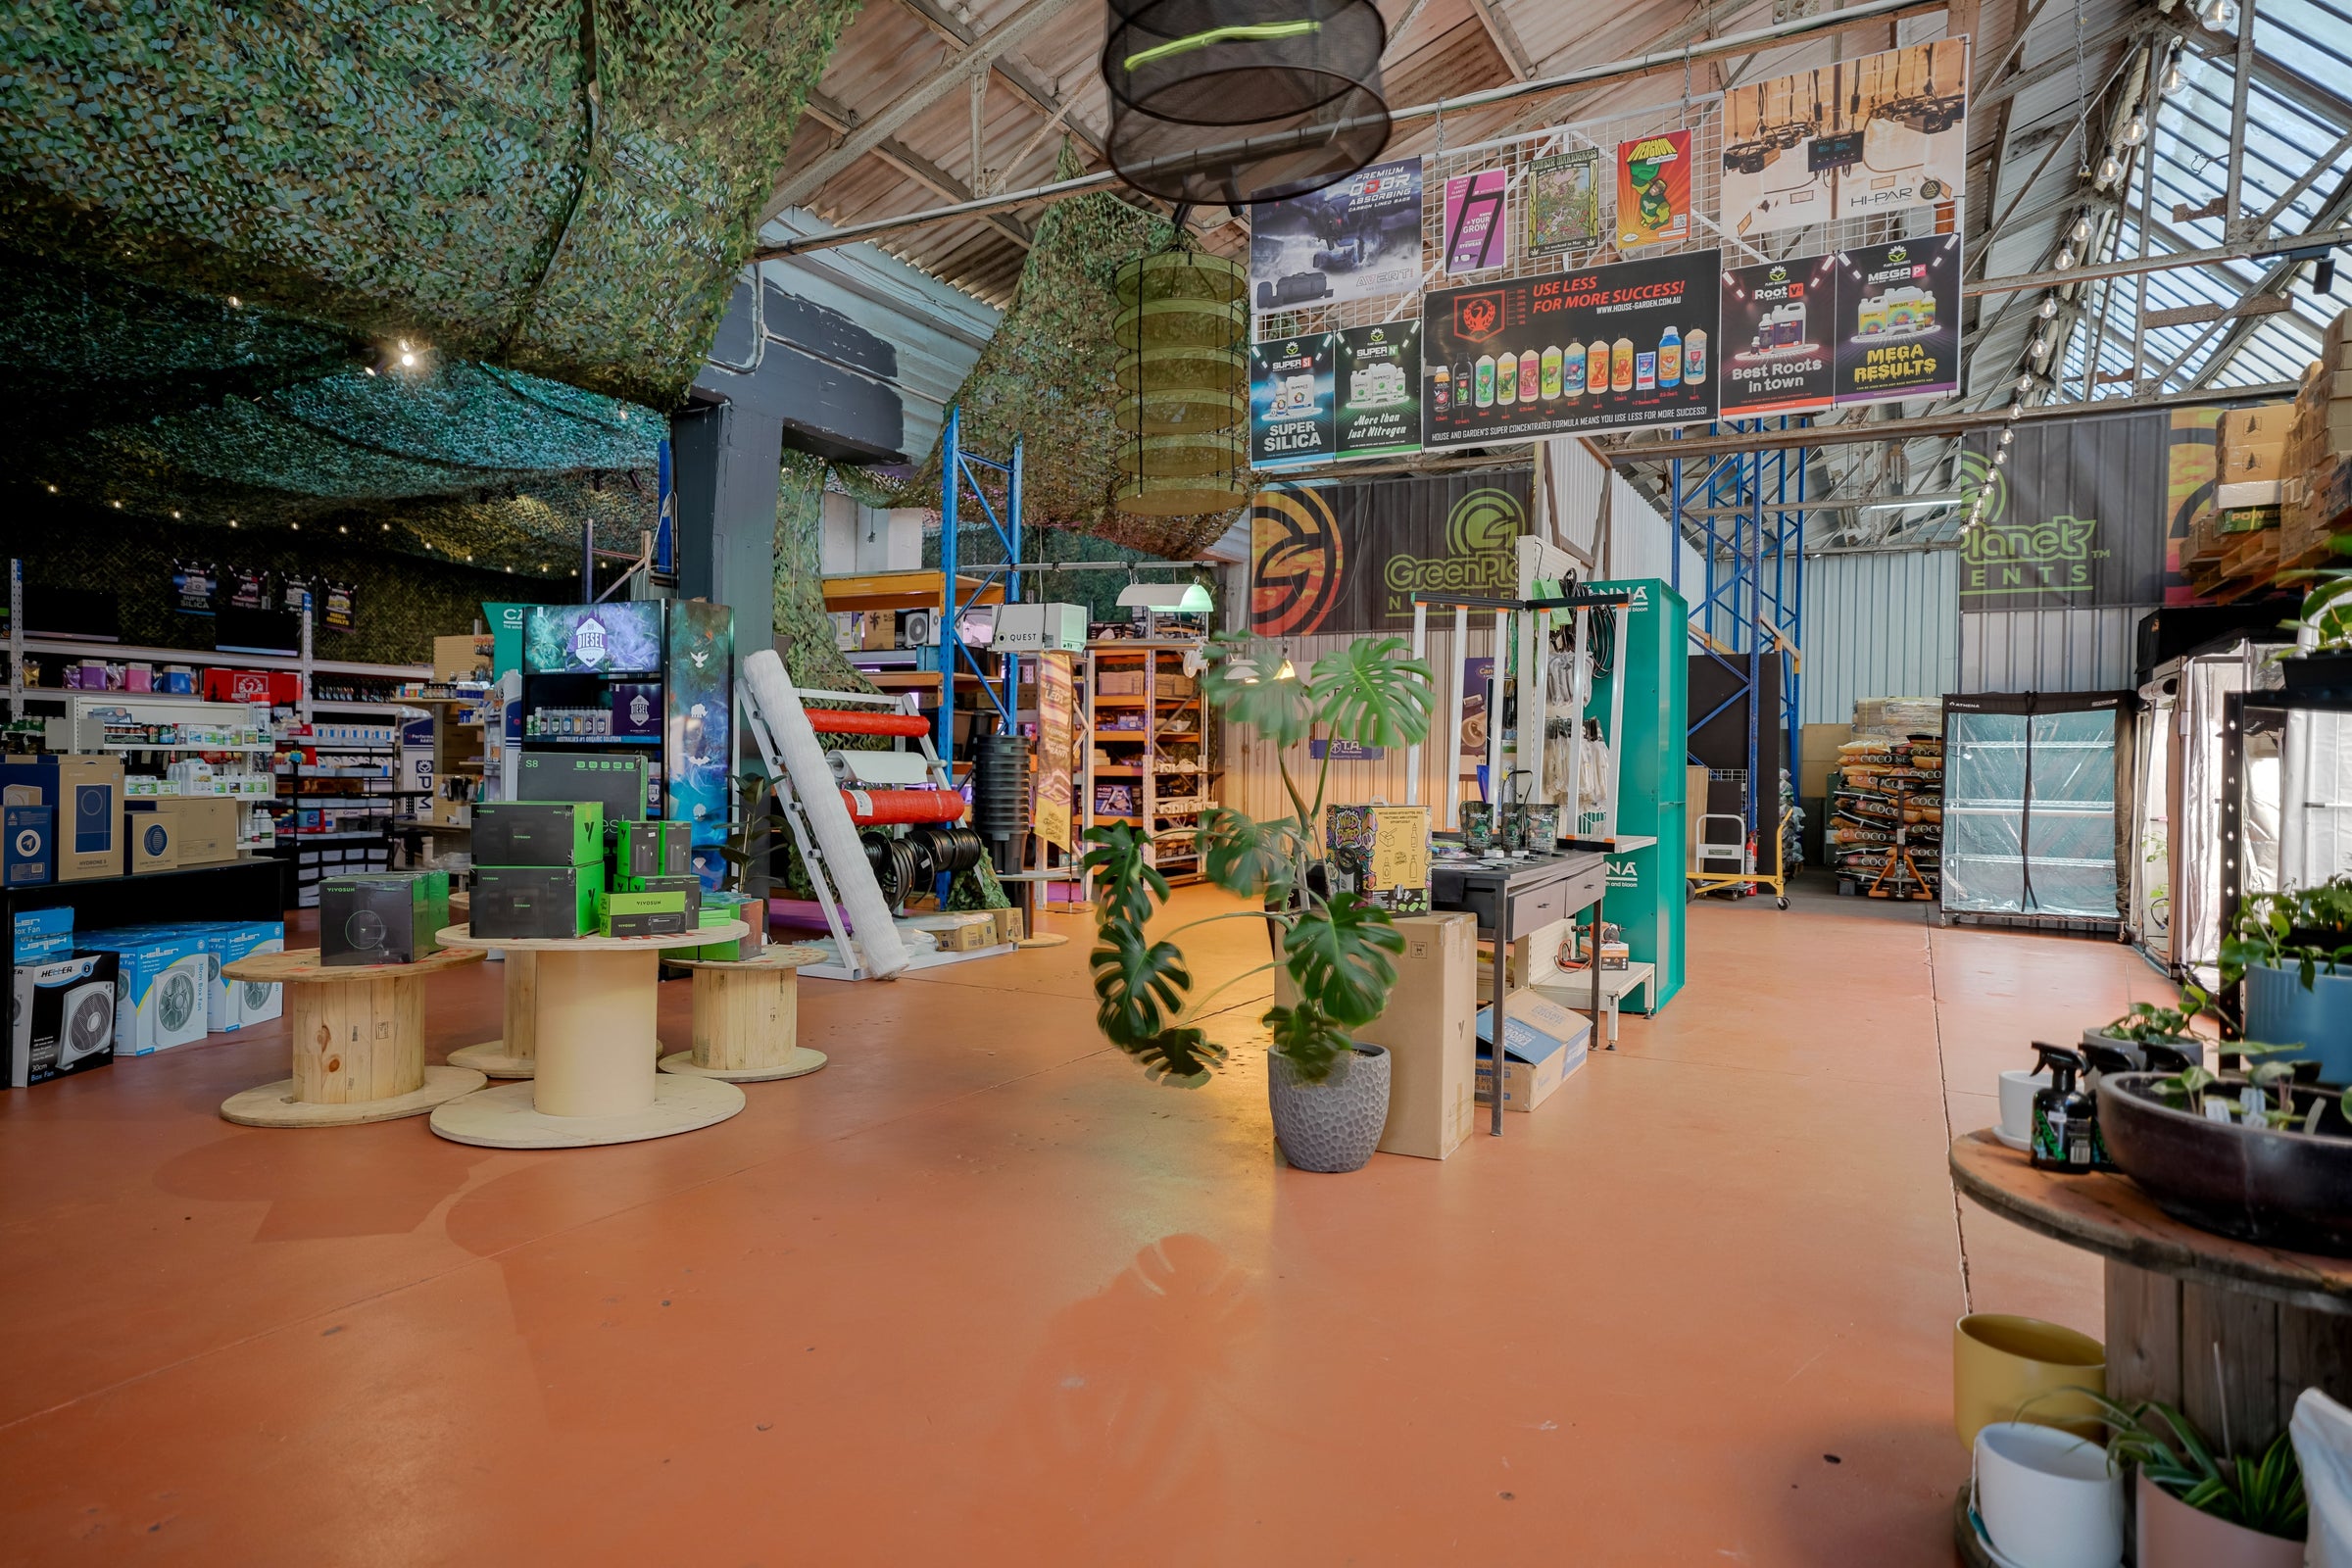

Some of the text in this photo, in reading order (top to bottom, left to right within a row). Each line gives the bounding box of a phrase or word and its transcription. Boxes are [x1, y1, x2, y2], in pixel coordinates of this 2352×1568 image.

[1355, 166, 1404, 181] PREMIUM
[1349, 174, 1411, 196] ODOR
[1348, 188, 1411, 206] ABSORBING
[1851, 188, 1912, 207] HI-PAR
[1471, 216, 1490, 224] YOUR
[1463, 223, 1487, 233] GROW
[1356, 268, 1410, 287] AVERT
[1868, 267, 1911, 282] MEGA
[1533, 276, 1597, 297] USE LESS
[1754, 286, 1788, 300] Root
[1533, 298, 1562, 314] FOR
[1565, 292, 1609, 308] MORE
[1612, 280, 1685, 303] SUCCESS!
[1596, 296, 1681, 314] WWW.HOUSE-GARDEN.COM.AU
[1357, 346, 1387, 356] SUPER
[1867, 344, 1924, 365] MEGA
[1272, 358, 1301, 370] SUPER
[1732, 360, 1822, 380] Best Roots
[1854, 358, 1937, 383] RESULTS
[1749, 377, 1804, 393] in town
[1354, 413, 1400, 426] More than
[1432, 406, 1707, 441] HOUSE AND GARDEN'S SUPER CONCENTRATED FORMULA MEANS YOU USE LESS FOR MORE SUCCESS!
[1270, 421, 1316, 436] SUPER
[1348, 425, 1406, 440] just Nitrogen
[1264, 432, 1322, 452] SILICA
[180, 600, 210, 609] SILICA
[326, 616, 349, 625] RESULTS
[578, 634, 604, 647] DIESEL
[1010, 633, 1036, 642] QUEST
[631, 704, 648, 714] DIESEL
[1342, 741, 1362, 750] T.A.
[1909, 770, 1941, 779] COCO
[1855, 830, 1886, 841] COCO
[41, 966, 72, 978] HELLER
[31, 1063, 48, 1073] 30cm
[31, 1073, 42, 1082] Box
